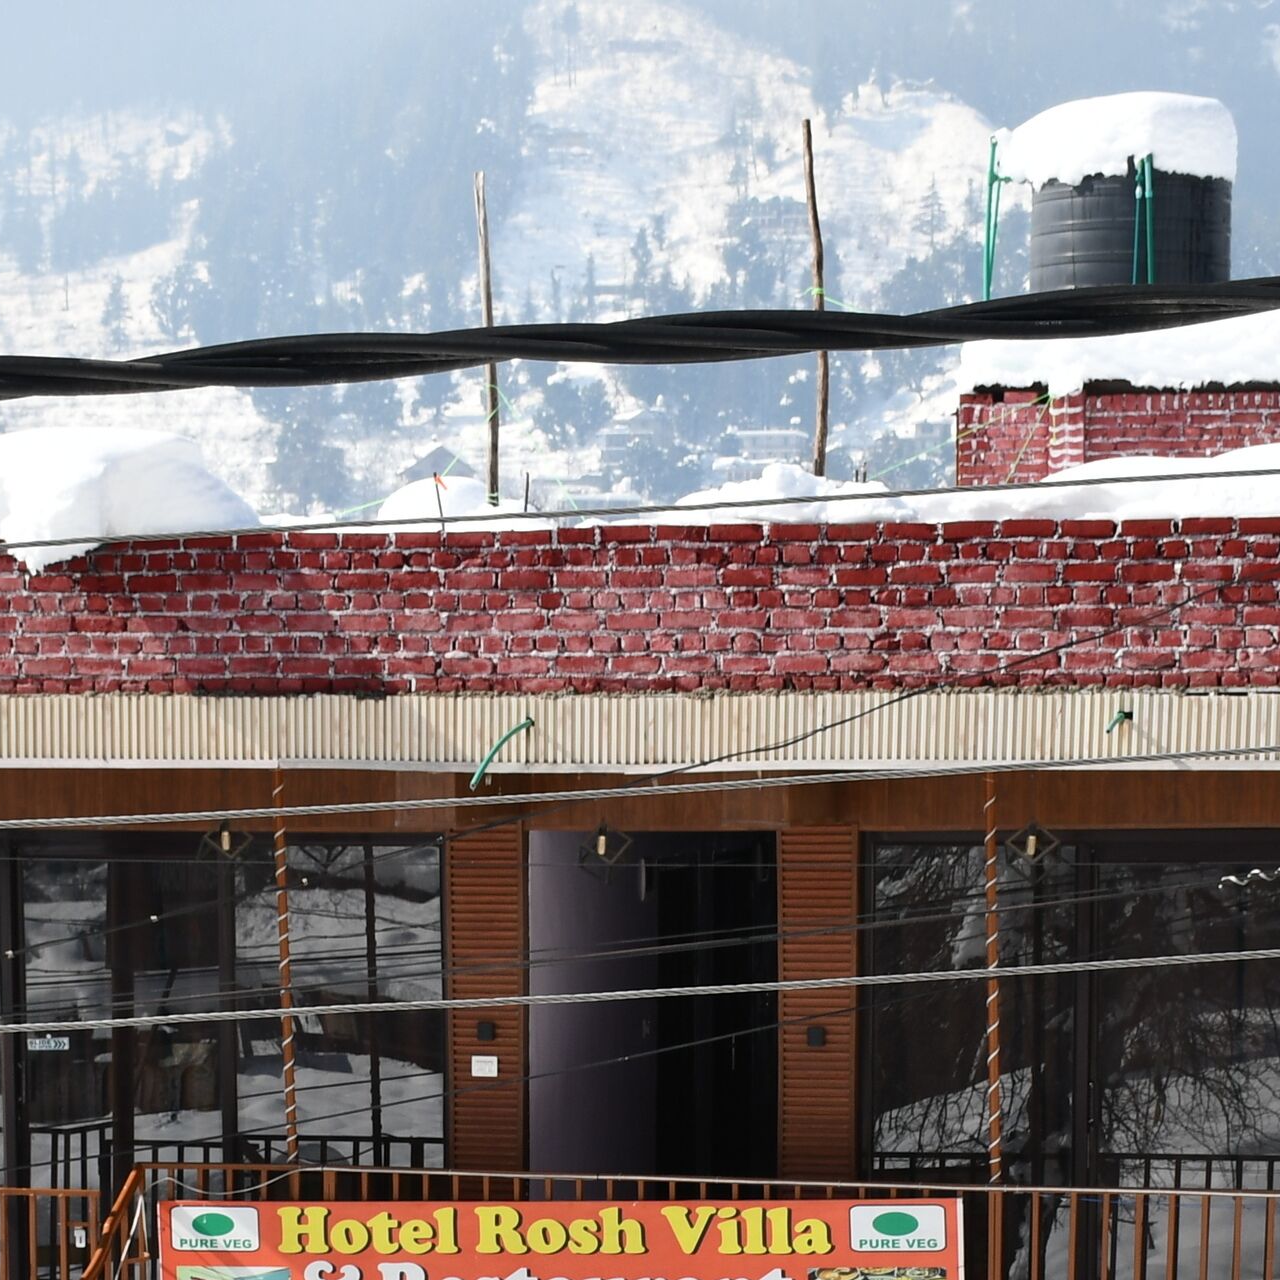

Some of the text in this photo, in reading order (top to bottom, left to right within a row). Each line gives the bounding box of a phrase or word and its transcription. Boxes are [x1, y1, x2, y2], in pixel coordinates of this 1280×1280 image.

[277, 1205, 835, 1255] Hotel Rosh Villa
[179, 1238, 253, 1250] PURE VEG
[858, 1238, 939, 1249] PURE VEG
